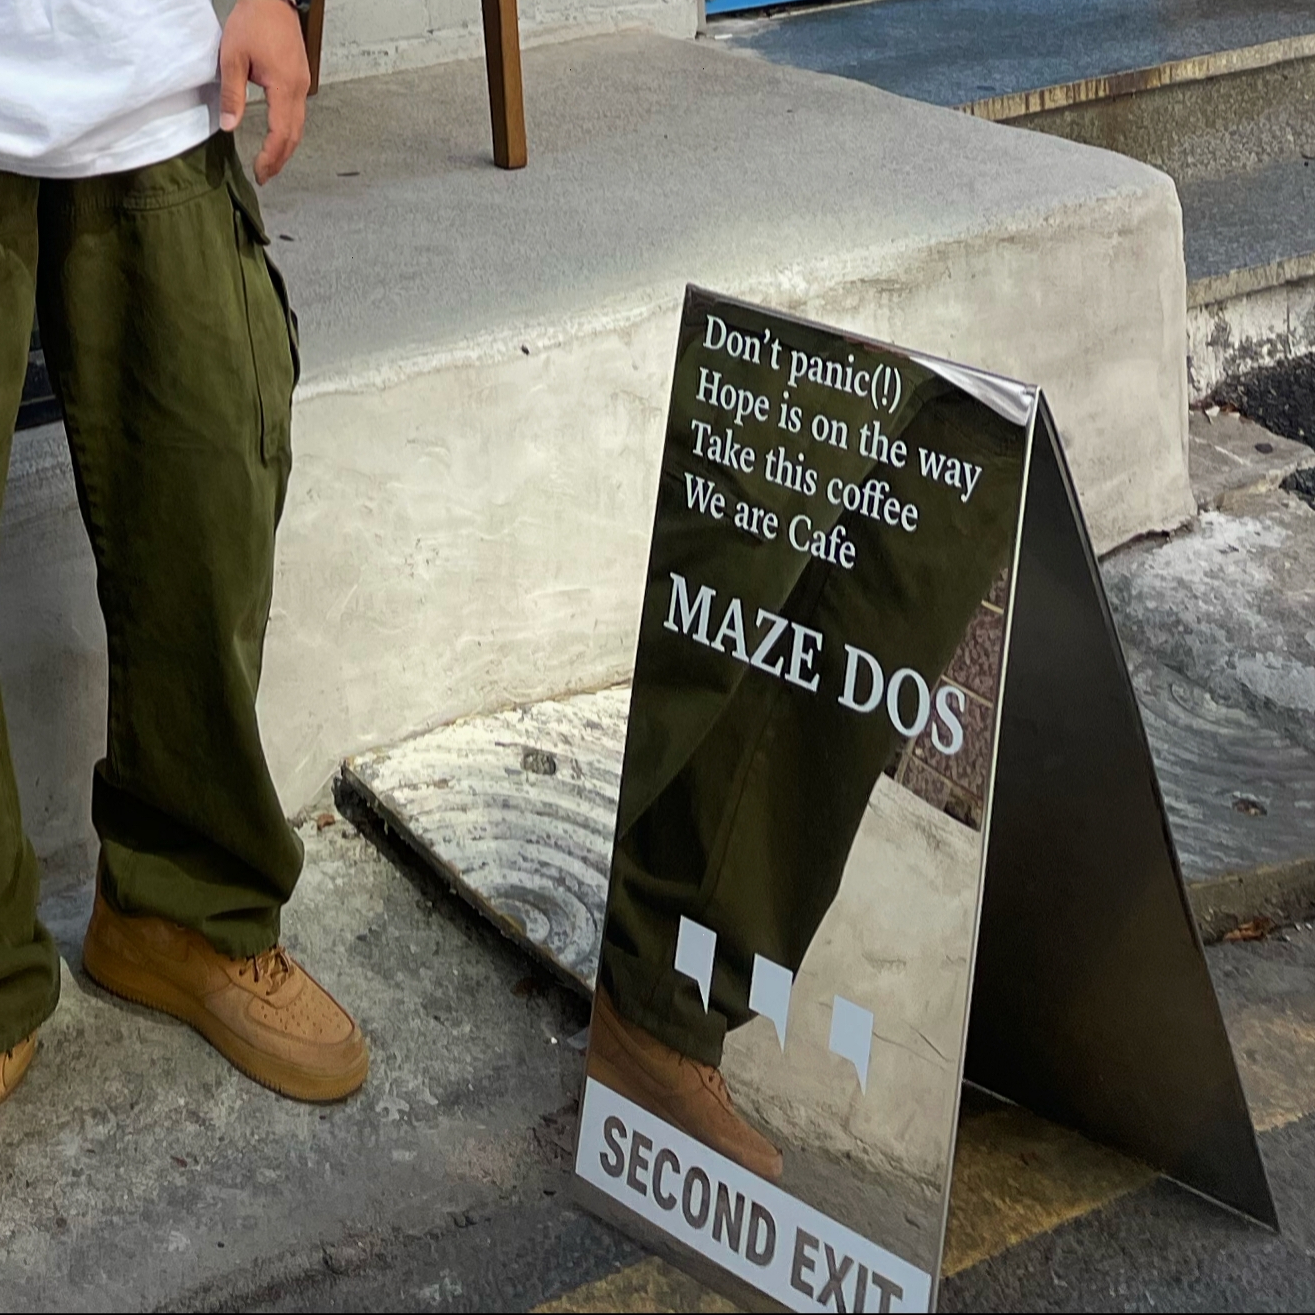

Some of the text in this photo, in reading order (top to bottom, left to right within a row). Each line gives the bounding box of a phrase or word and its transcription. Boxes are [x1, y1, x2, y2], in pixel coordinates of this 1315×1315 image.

[702, 314, 902, 414] Don't panic(!)
[691, 419, 919, 532] Take this coffee
[696, 367, 983, 503] Hope is on the way
[684, 472, 857, 569] We are Cafe
[662, 571, 967, 756] MAZE DOS
[599, 1115, 777, 1267] SECOND
